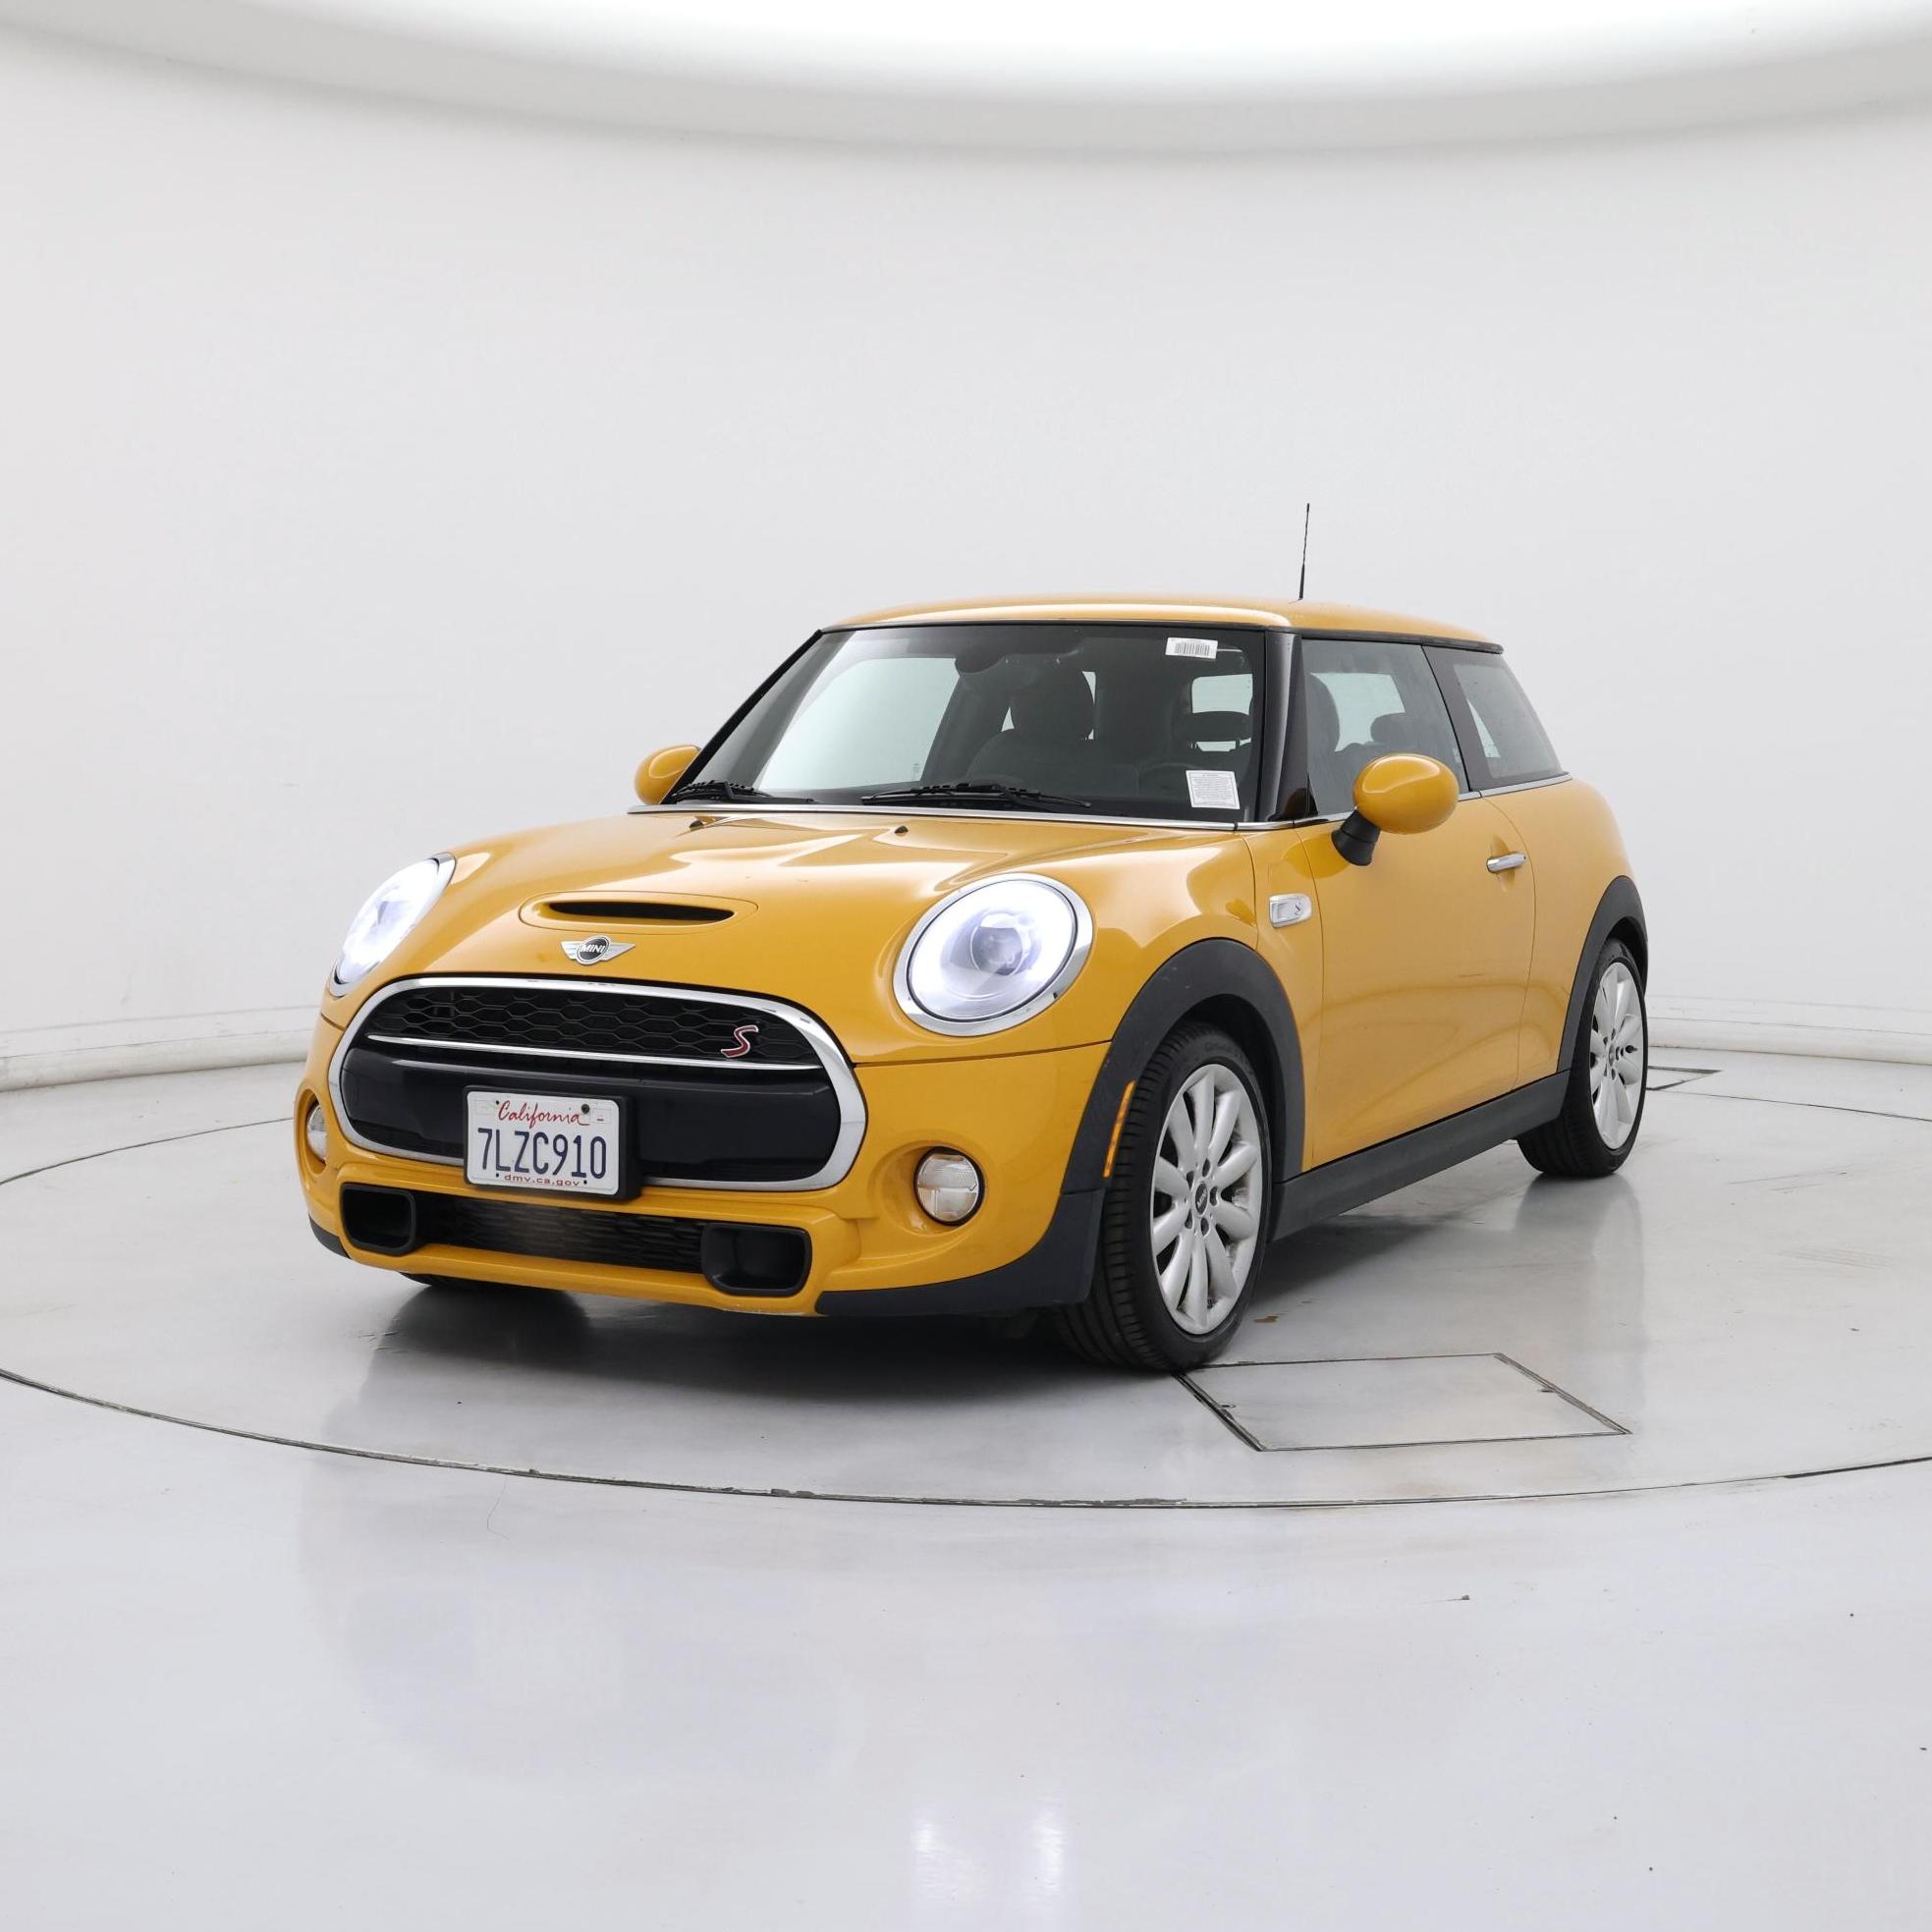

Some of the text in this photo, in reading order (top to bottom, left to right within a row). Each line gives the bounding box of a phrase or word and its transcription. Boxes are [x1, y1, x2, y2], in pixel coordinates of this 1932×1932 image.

[580, 944, 606, 954] MINI
[720, 1024, 758, 1058] S
[497, 1099, 590, 1129] California
[477, 1127, 607, 1180] 7LZC910
[504, 1173, 580, 1187] dmv.ca.gov
